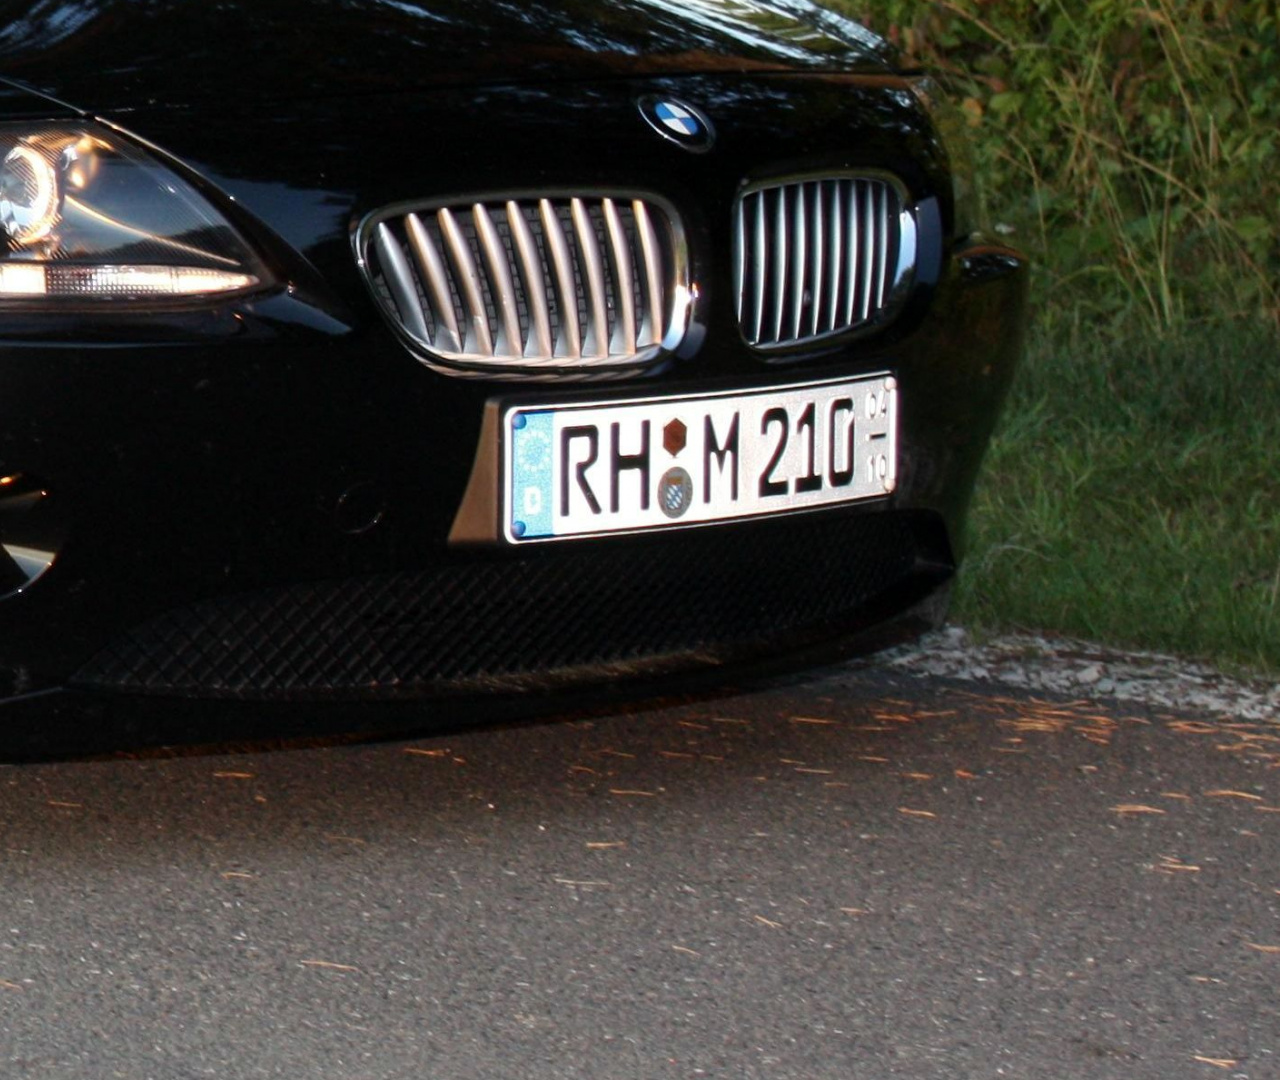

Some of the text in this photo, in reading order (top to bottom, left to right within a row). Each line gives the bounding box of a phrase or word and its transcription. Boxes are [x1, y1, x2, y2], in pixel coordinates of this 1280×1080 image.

[560, 419, 652, 517] RH
[703, 412, 740, 504] M
[757, 397, 855, 498] 210
